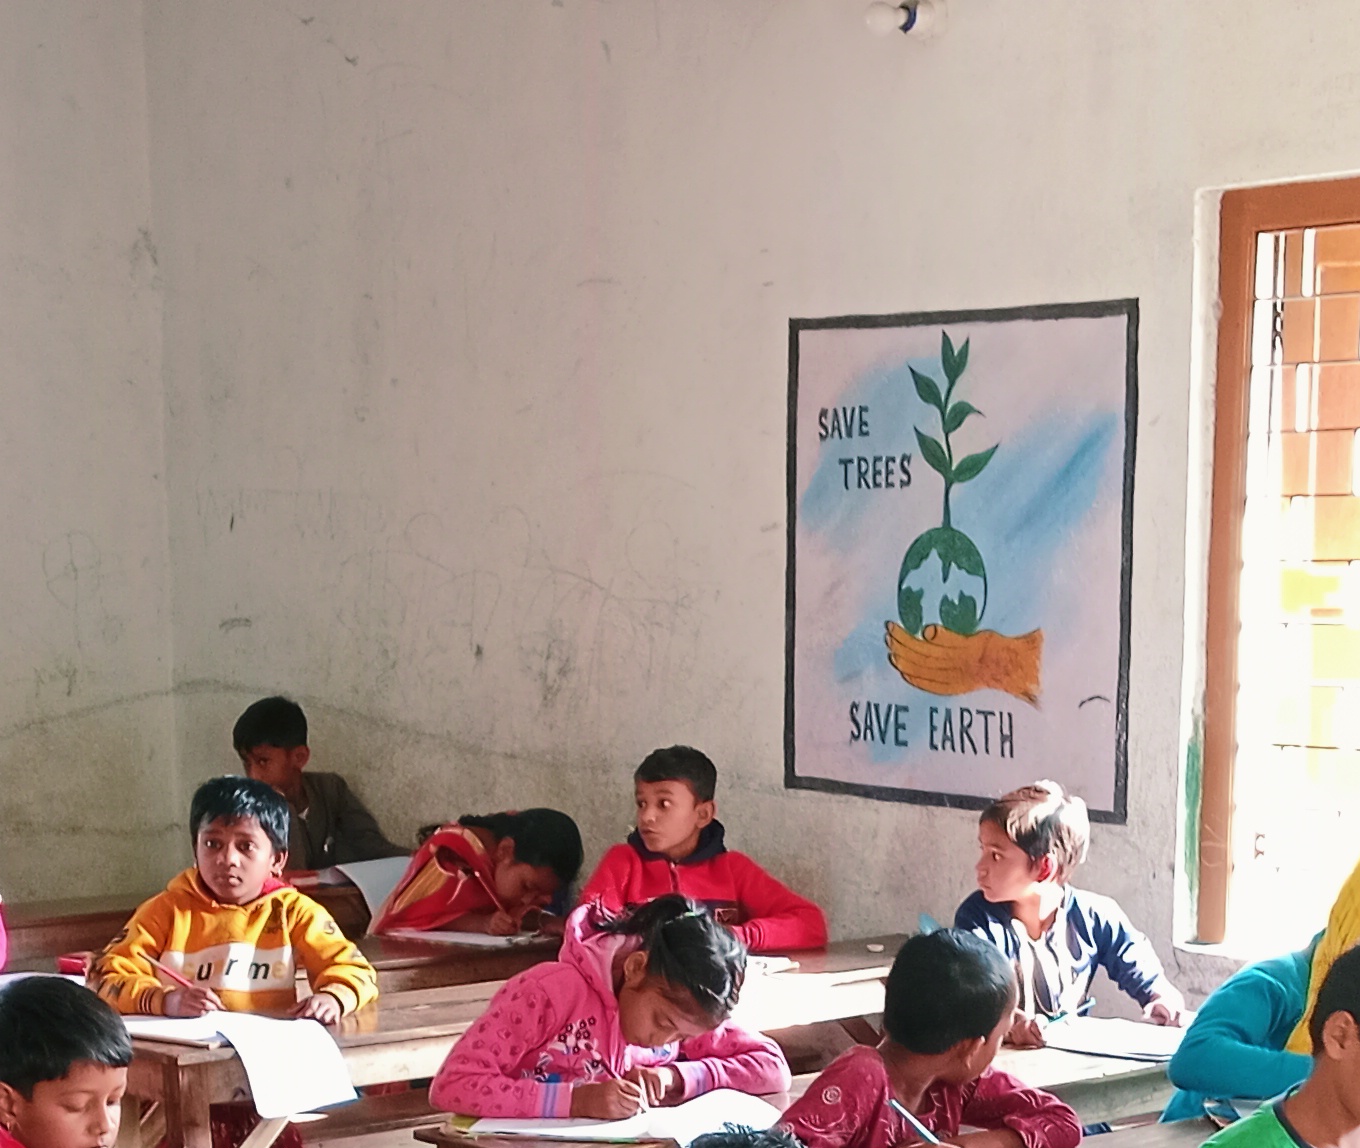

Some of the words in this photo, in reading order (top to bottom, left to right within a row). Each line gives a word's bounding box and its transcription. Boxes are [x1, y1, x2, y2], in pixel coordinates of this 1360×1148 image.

[818, 405, 870, 441] SAVE
[839, 453, 912, 490] TREES
[849, 701, 910, 748] SAVE
[927, 706, 1015, 758] EARTH
